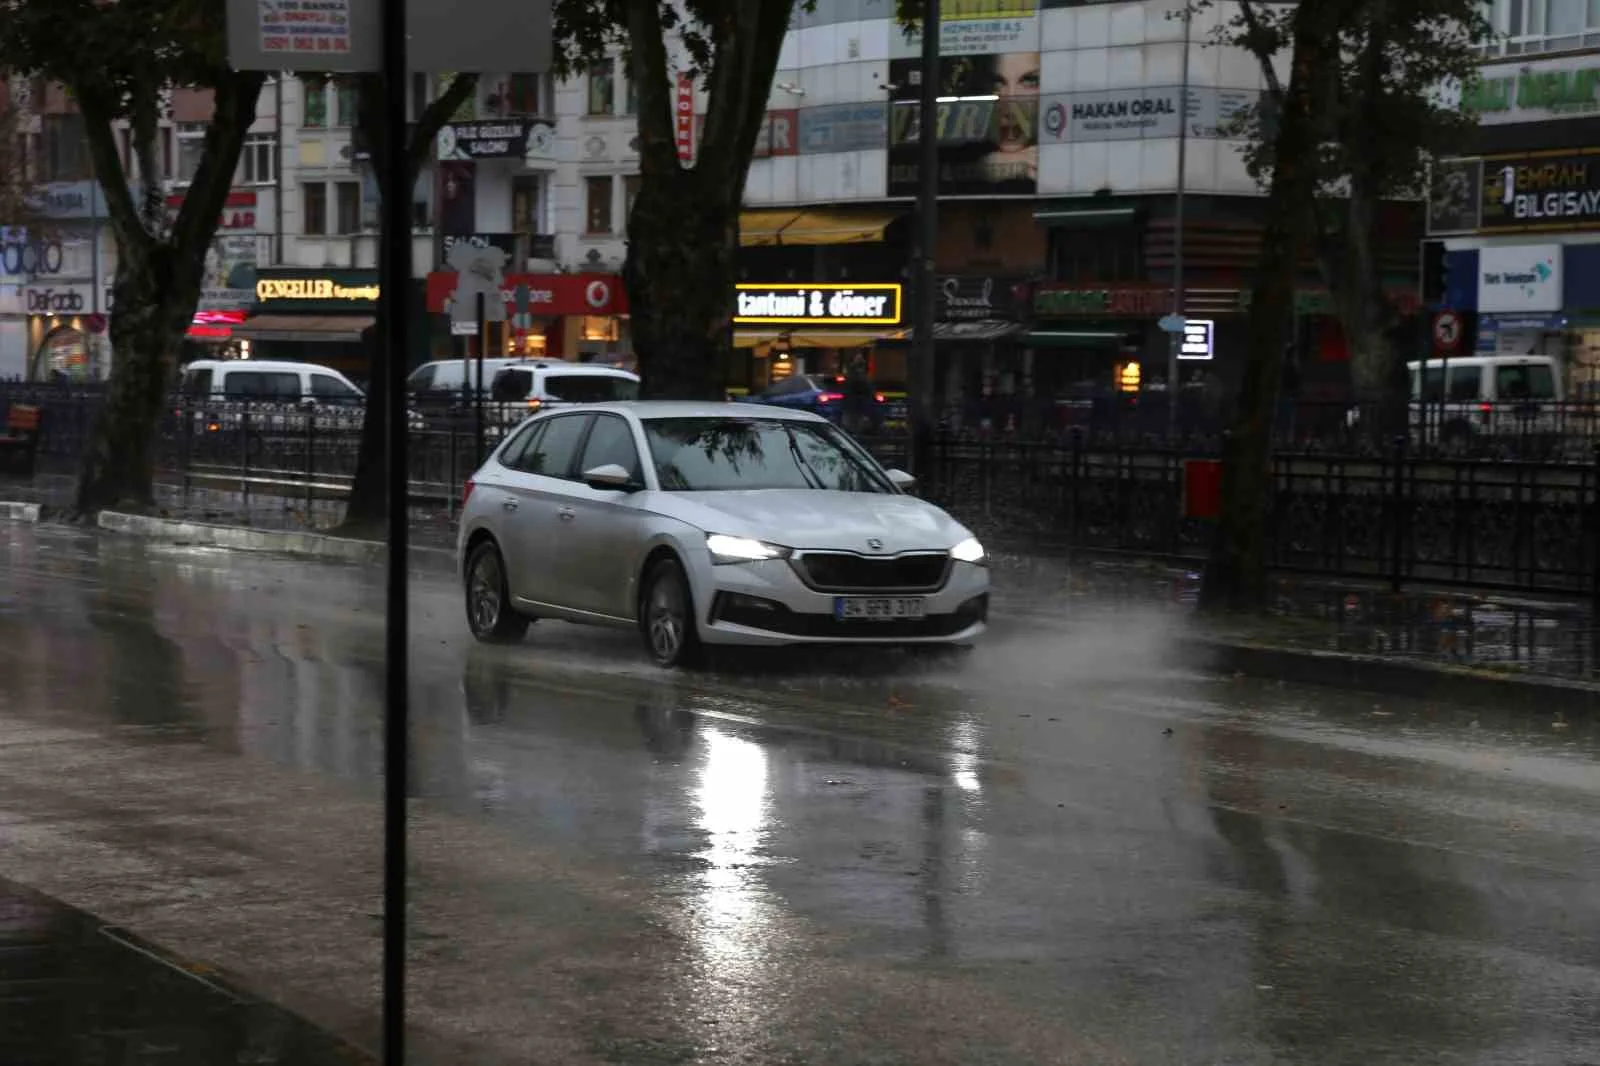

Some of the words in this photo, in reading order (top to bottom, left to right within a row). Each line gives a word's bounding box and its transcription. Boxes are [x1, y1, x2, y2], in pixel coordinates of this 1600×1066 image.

[1071, 100, 1126, 120] HAKAN
[1130, 97, 1175, 116] ORAL
[1517, 164, 1587, 188] EMRAH
[28, 288, 83, 310] DeFacto
[738, 290, 806, 316] tantuni
[809, 290, 825, 316] &
[828, 290, 887, 316] döner
